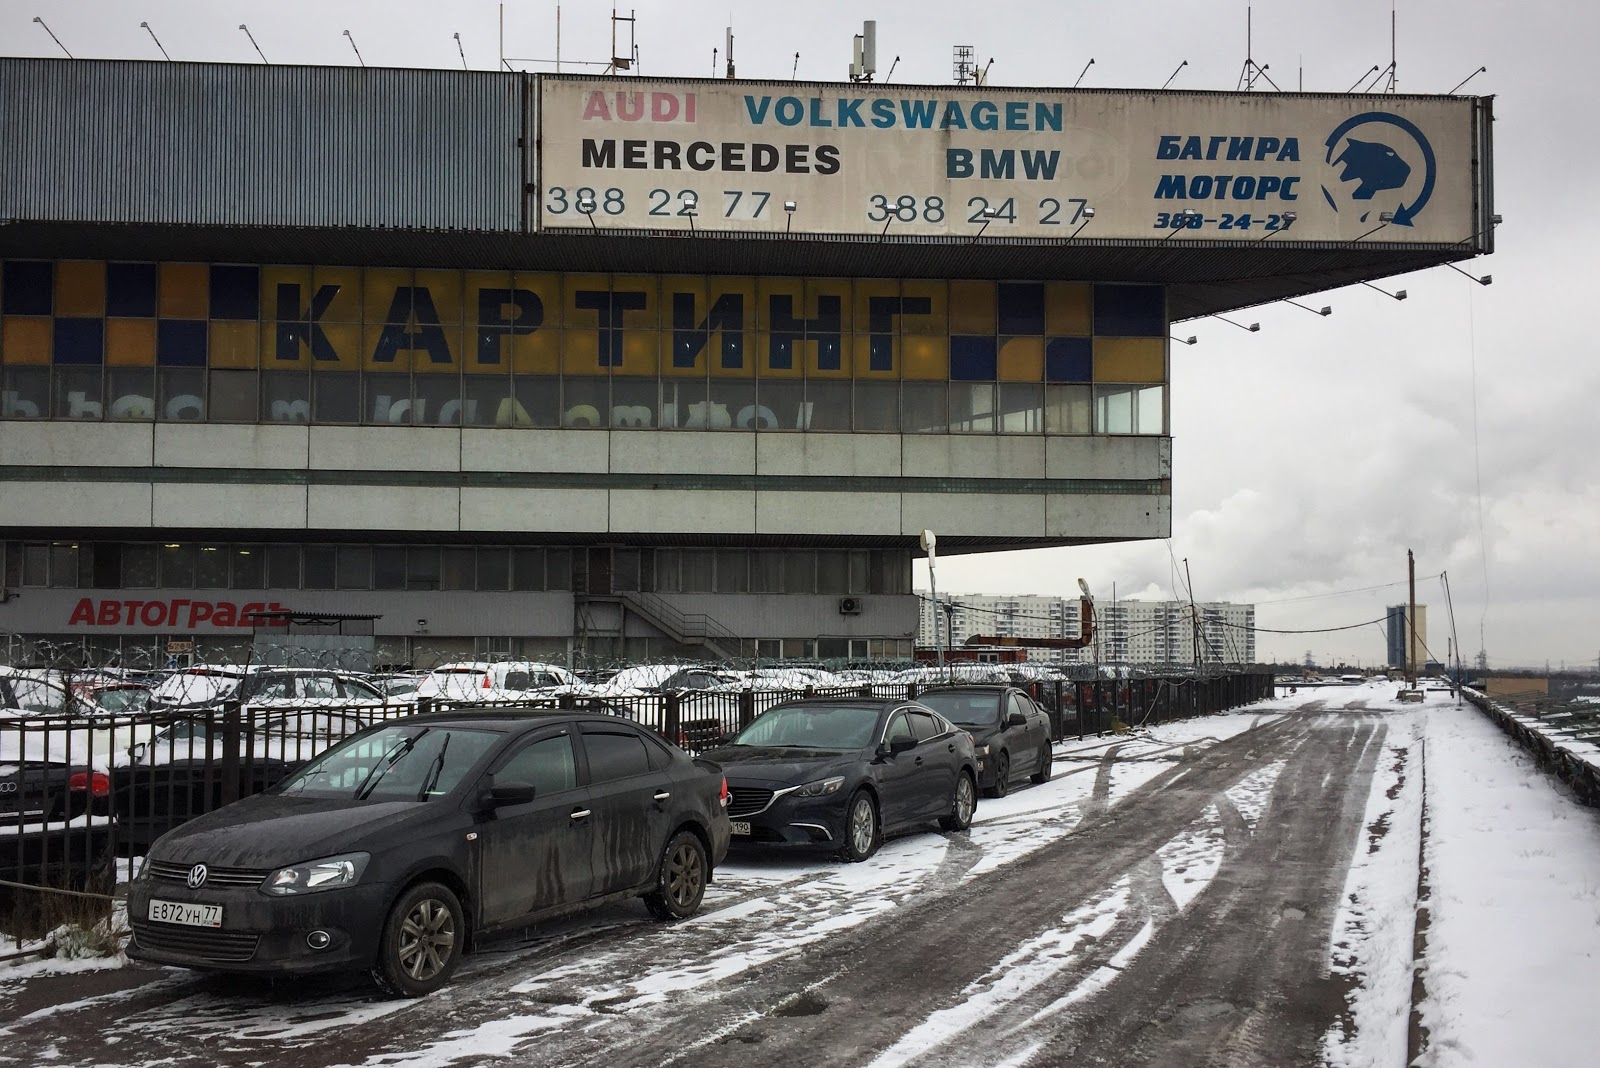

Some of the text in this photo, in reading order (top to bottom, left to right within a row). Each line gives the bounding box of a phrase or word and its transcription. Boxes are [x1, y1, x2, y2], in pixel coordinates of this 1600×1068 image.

[582, 91, 1063, 132] AUDI VOLKSWAGEN
[582, 138, 1061, 181] MERCEDES BMW
[1156, 135, 1301, 162] БАГИРА
[546, 186, 771, 219] 388 22 77
[1154, 174, 1301, 201] МОТОРС
[867, 194, 1088, 225] 388 24 27
[276, 282, 932, 371] КАРТИНГ
[204, 906, 218, 920] 77
